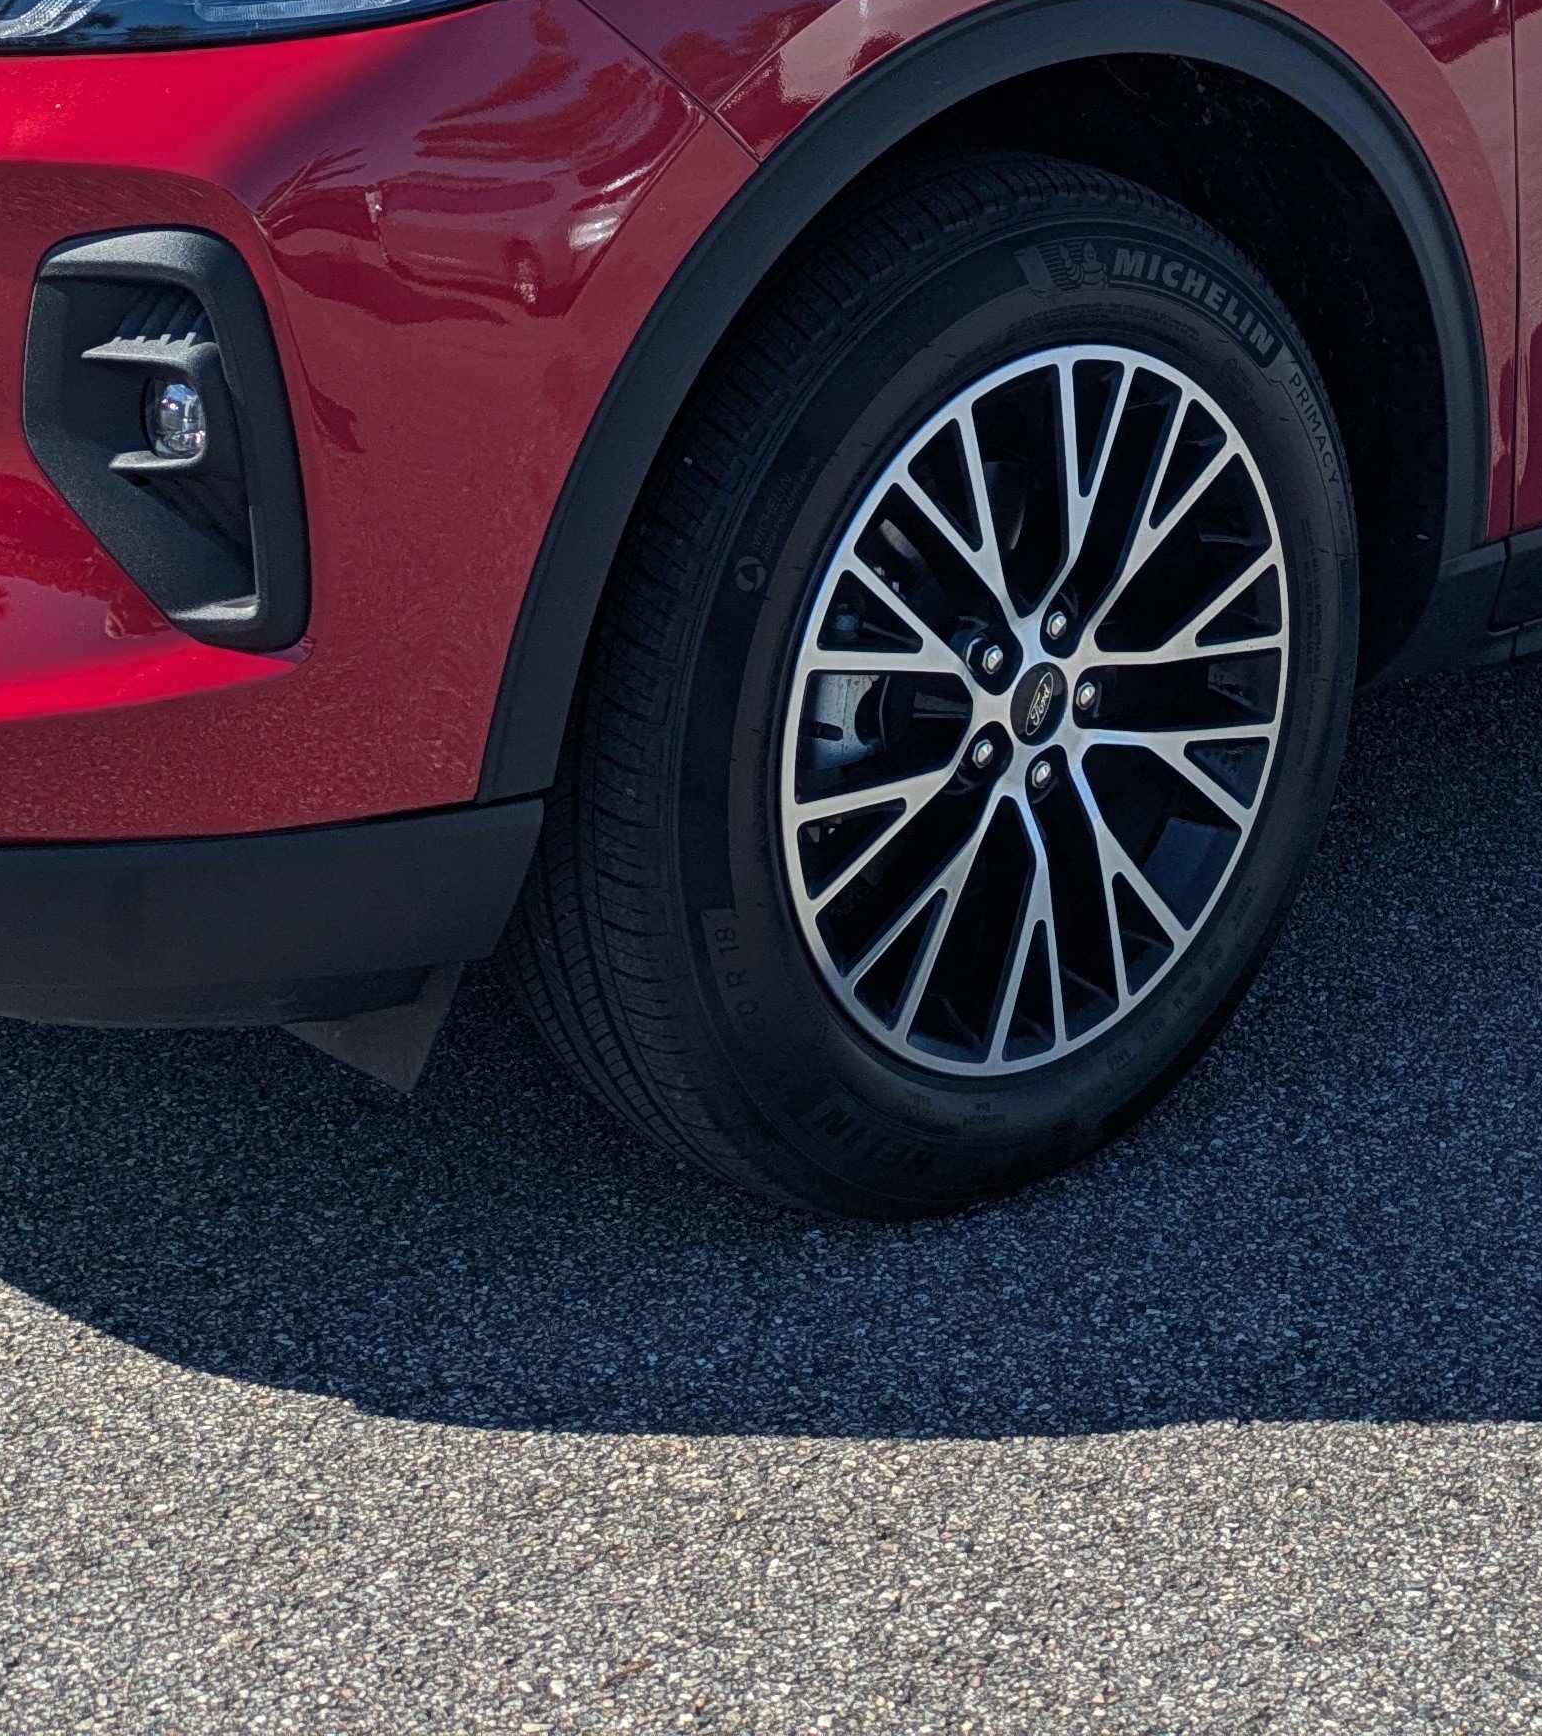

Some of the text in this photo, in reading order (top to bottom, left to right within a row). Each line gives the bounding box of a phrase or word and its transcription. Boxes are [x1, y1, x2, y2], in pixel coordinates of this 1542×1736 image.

[1113, 247, 1277, 358] MICHELIN
[1288, 372, 1340, 486] PRIMACY
[1030, 683, 1051, 726] Ford
